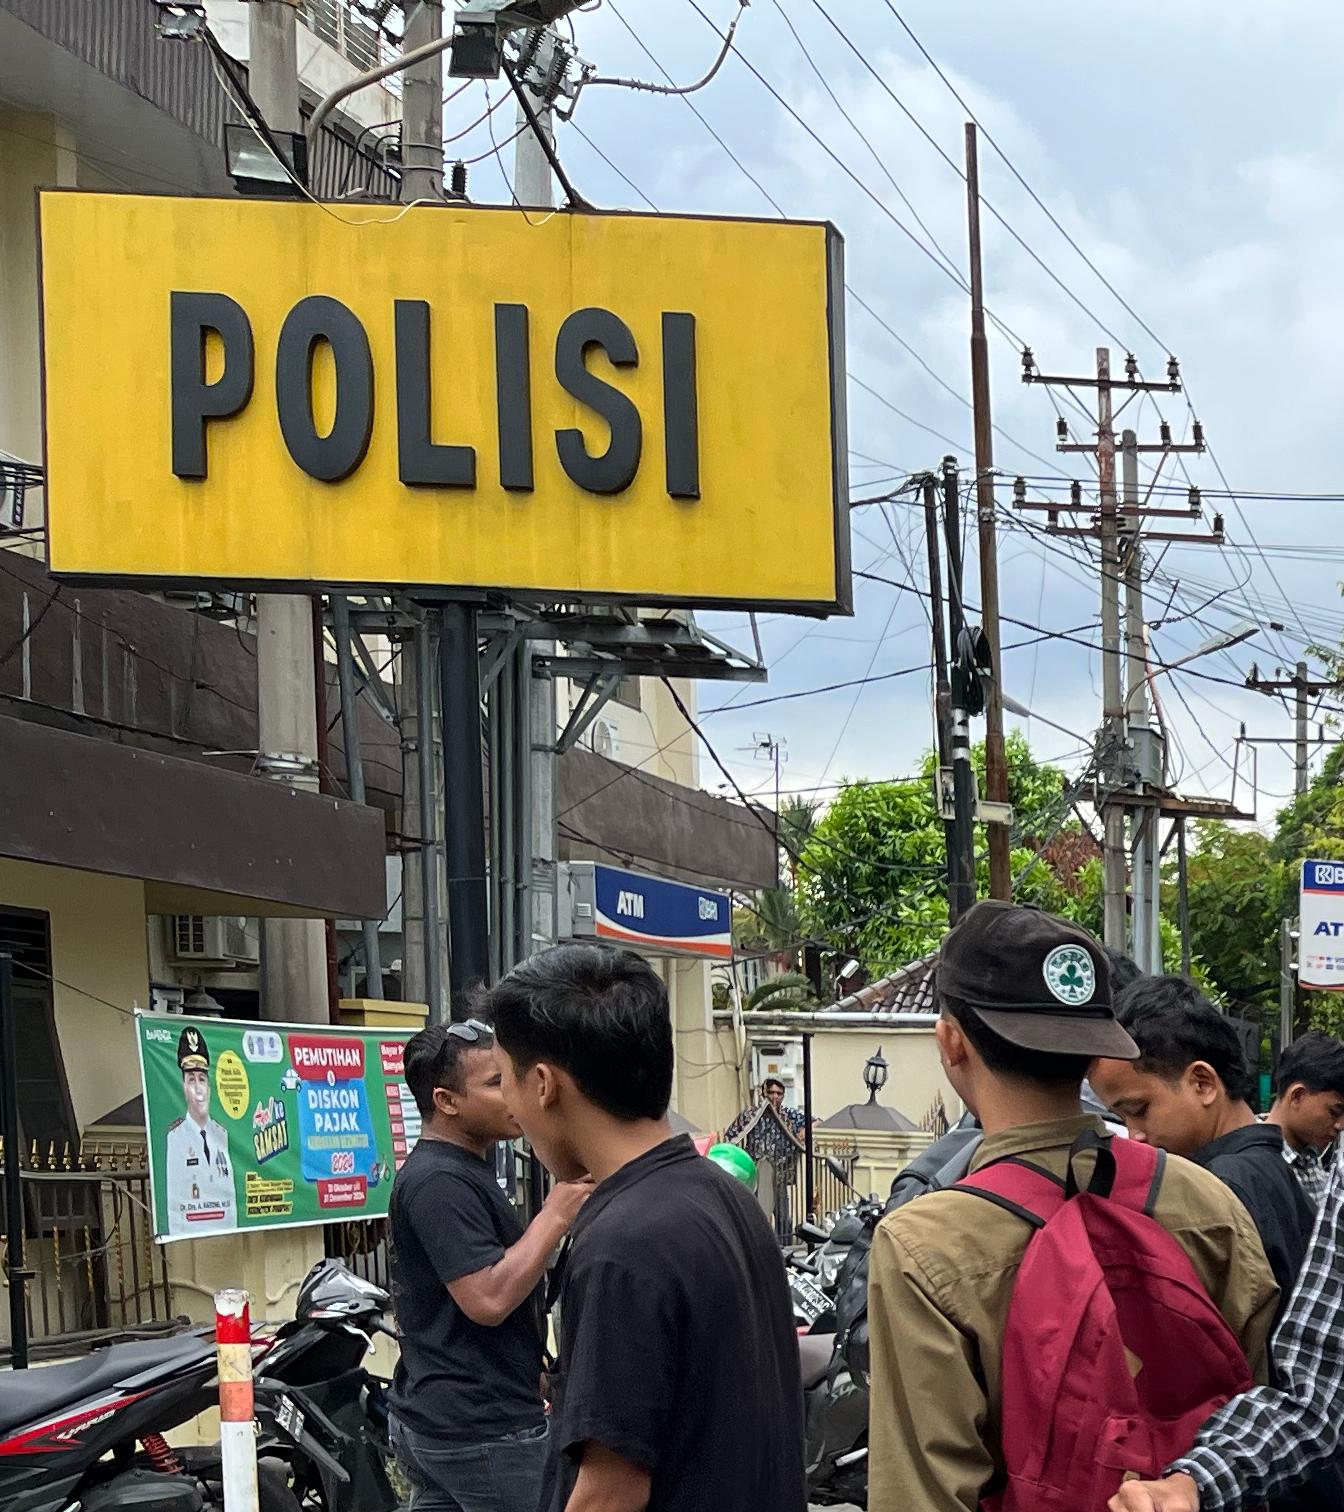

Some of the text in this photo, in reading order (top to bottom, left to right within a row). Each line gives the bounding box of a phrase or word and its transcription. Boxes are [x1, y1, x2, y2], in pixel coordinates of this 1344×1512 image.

[171, 290, 701, 500] POLISI
[616, 890, 645, 919] ATM
[294, 1047, 361, 1067] PEMUTIHAN
[307, 1089, 359, 1109] DISKON
[314, 1112, 360, 1132] PAJAK
[253, 1120, 288, 1162] SAMSAT
[332, 1152, 355, 1173] 2024
